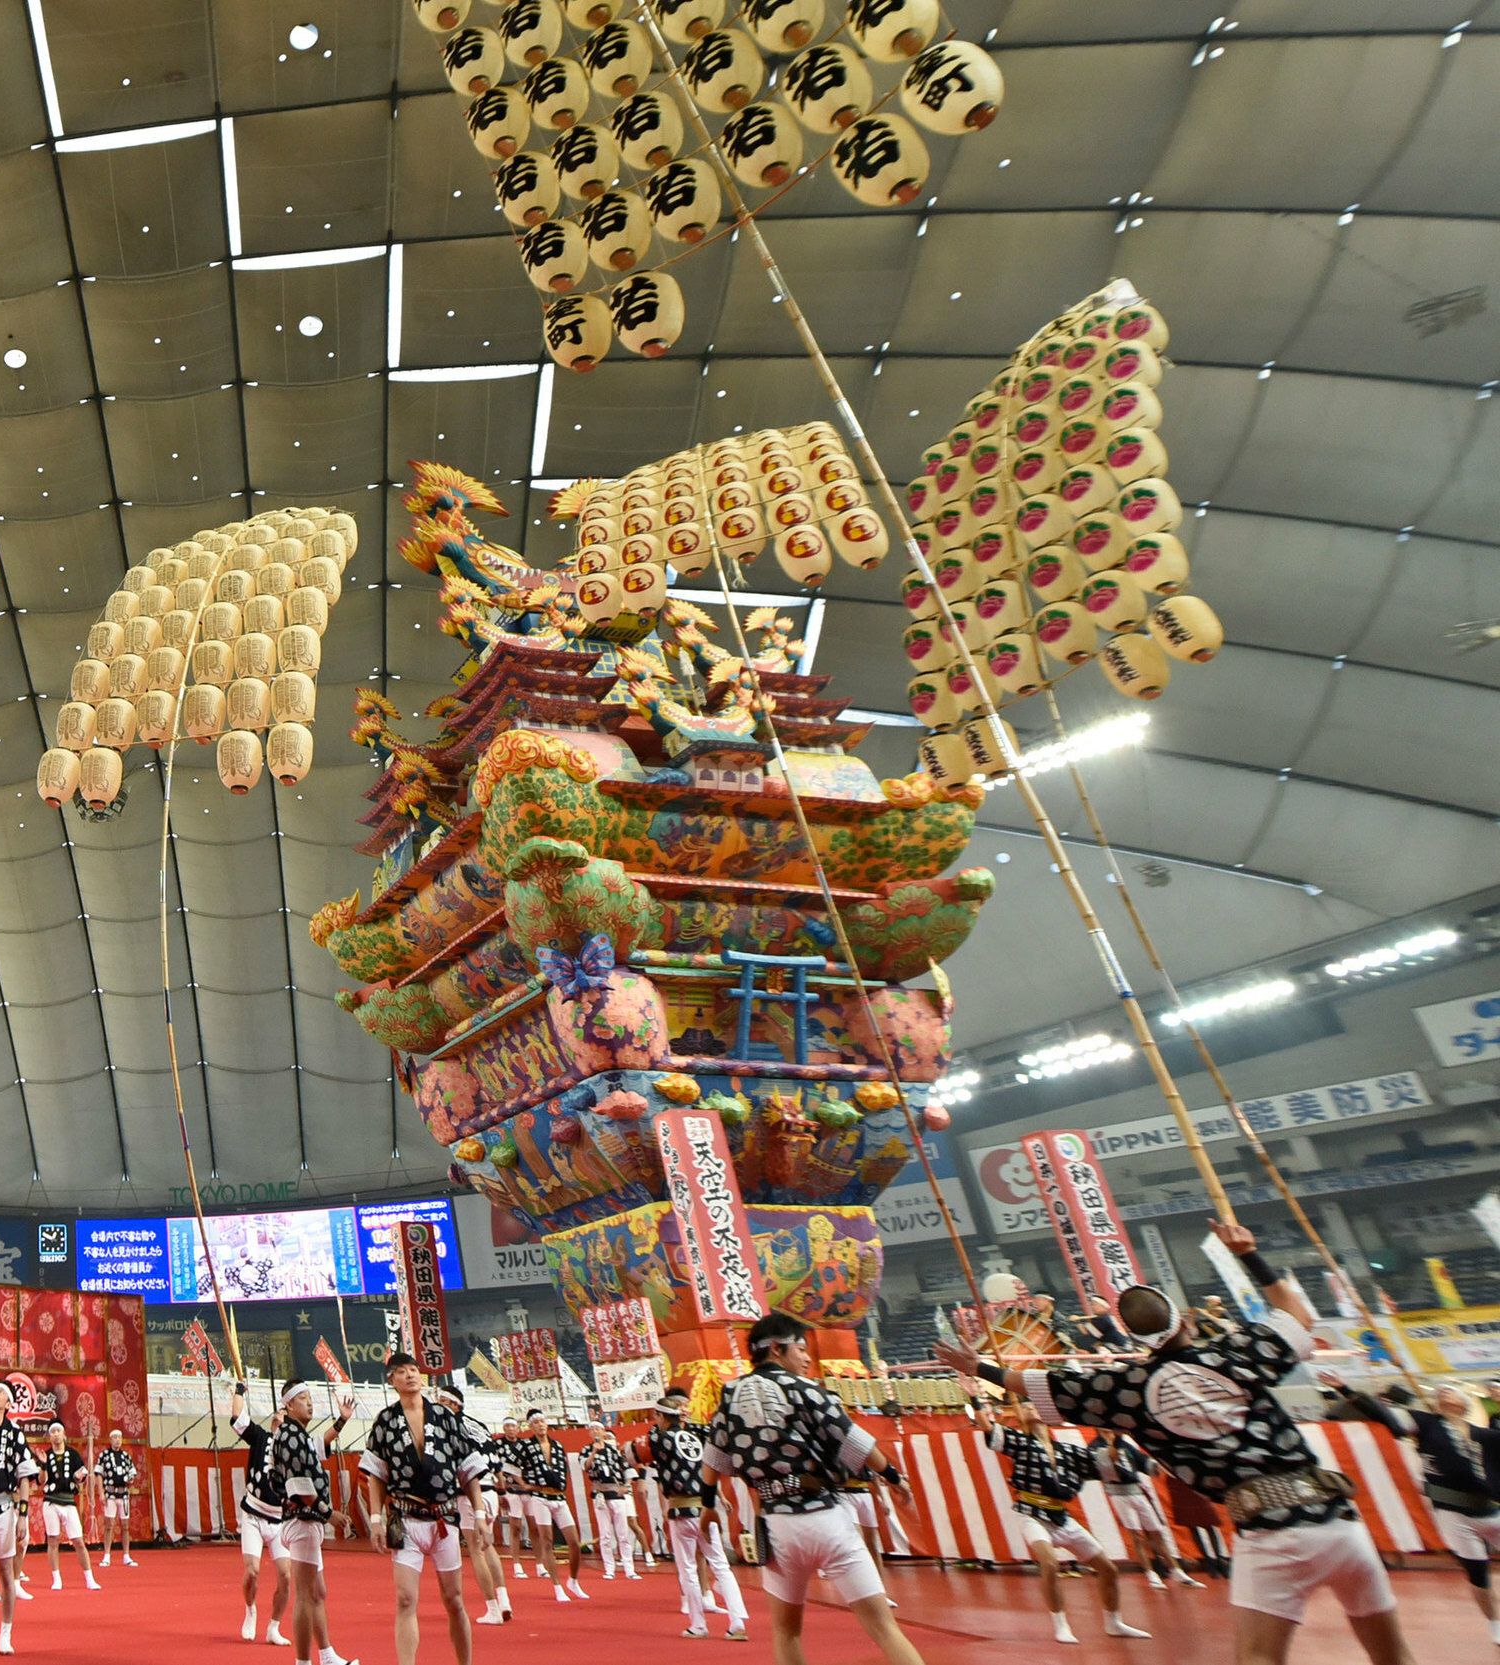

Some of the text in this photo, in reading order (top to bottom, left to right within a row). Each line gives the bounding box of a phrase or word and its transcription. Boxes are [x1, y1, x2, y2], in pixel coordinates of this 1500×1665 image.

[1239, 1073, 1423, 1130] 能美防災
[240, 1181, 296, 1202] DOME
[1068, 1161, 1119, 1237] 秋田県
[90, 1230, 156, 1243] 会場内で不審な物や
[693, 1140, 762, 1321] 天空の不夜城
[83, 1246, 163, 1259] 不審な人を見かけましたら
[494, 1248, 547, 1270] マルハン
[80, 1278, 169, 1291] 会場係員にお知らせください
[411, 1247, 444, 1368] 秋田県 能代市
[147, 1318, 208, 1331] サッポロビル
